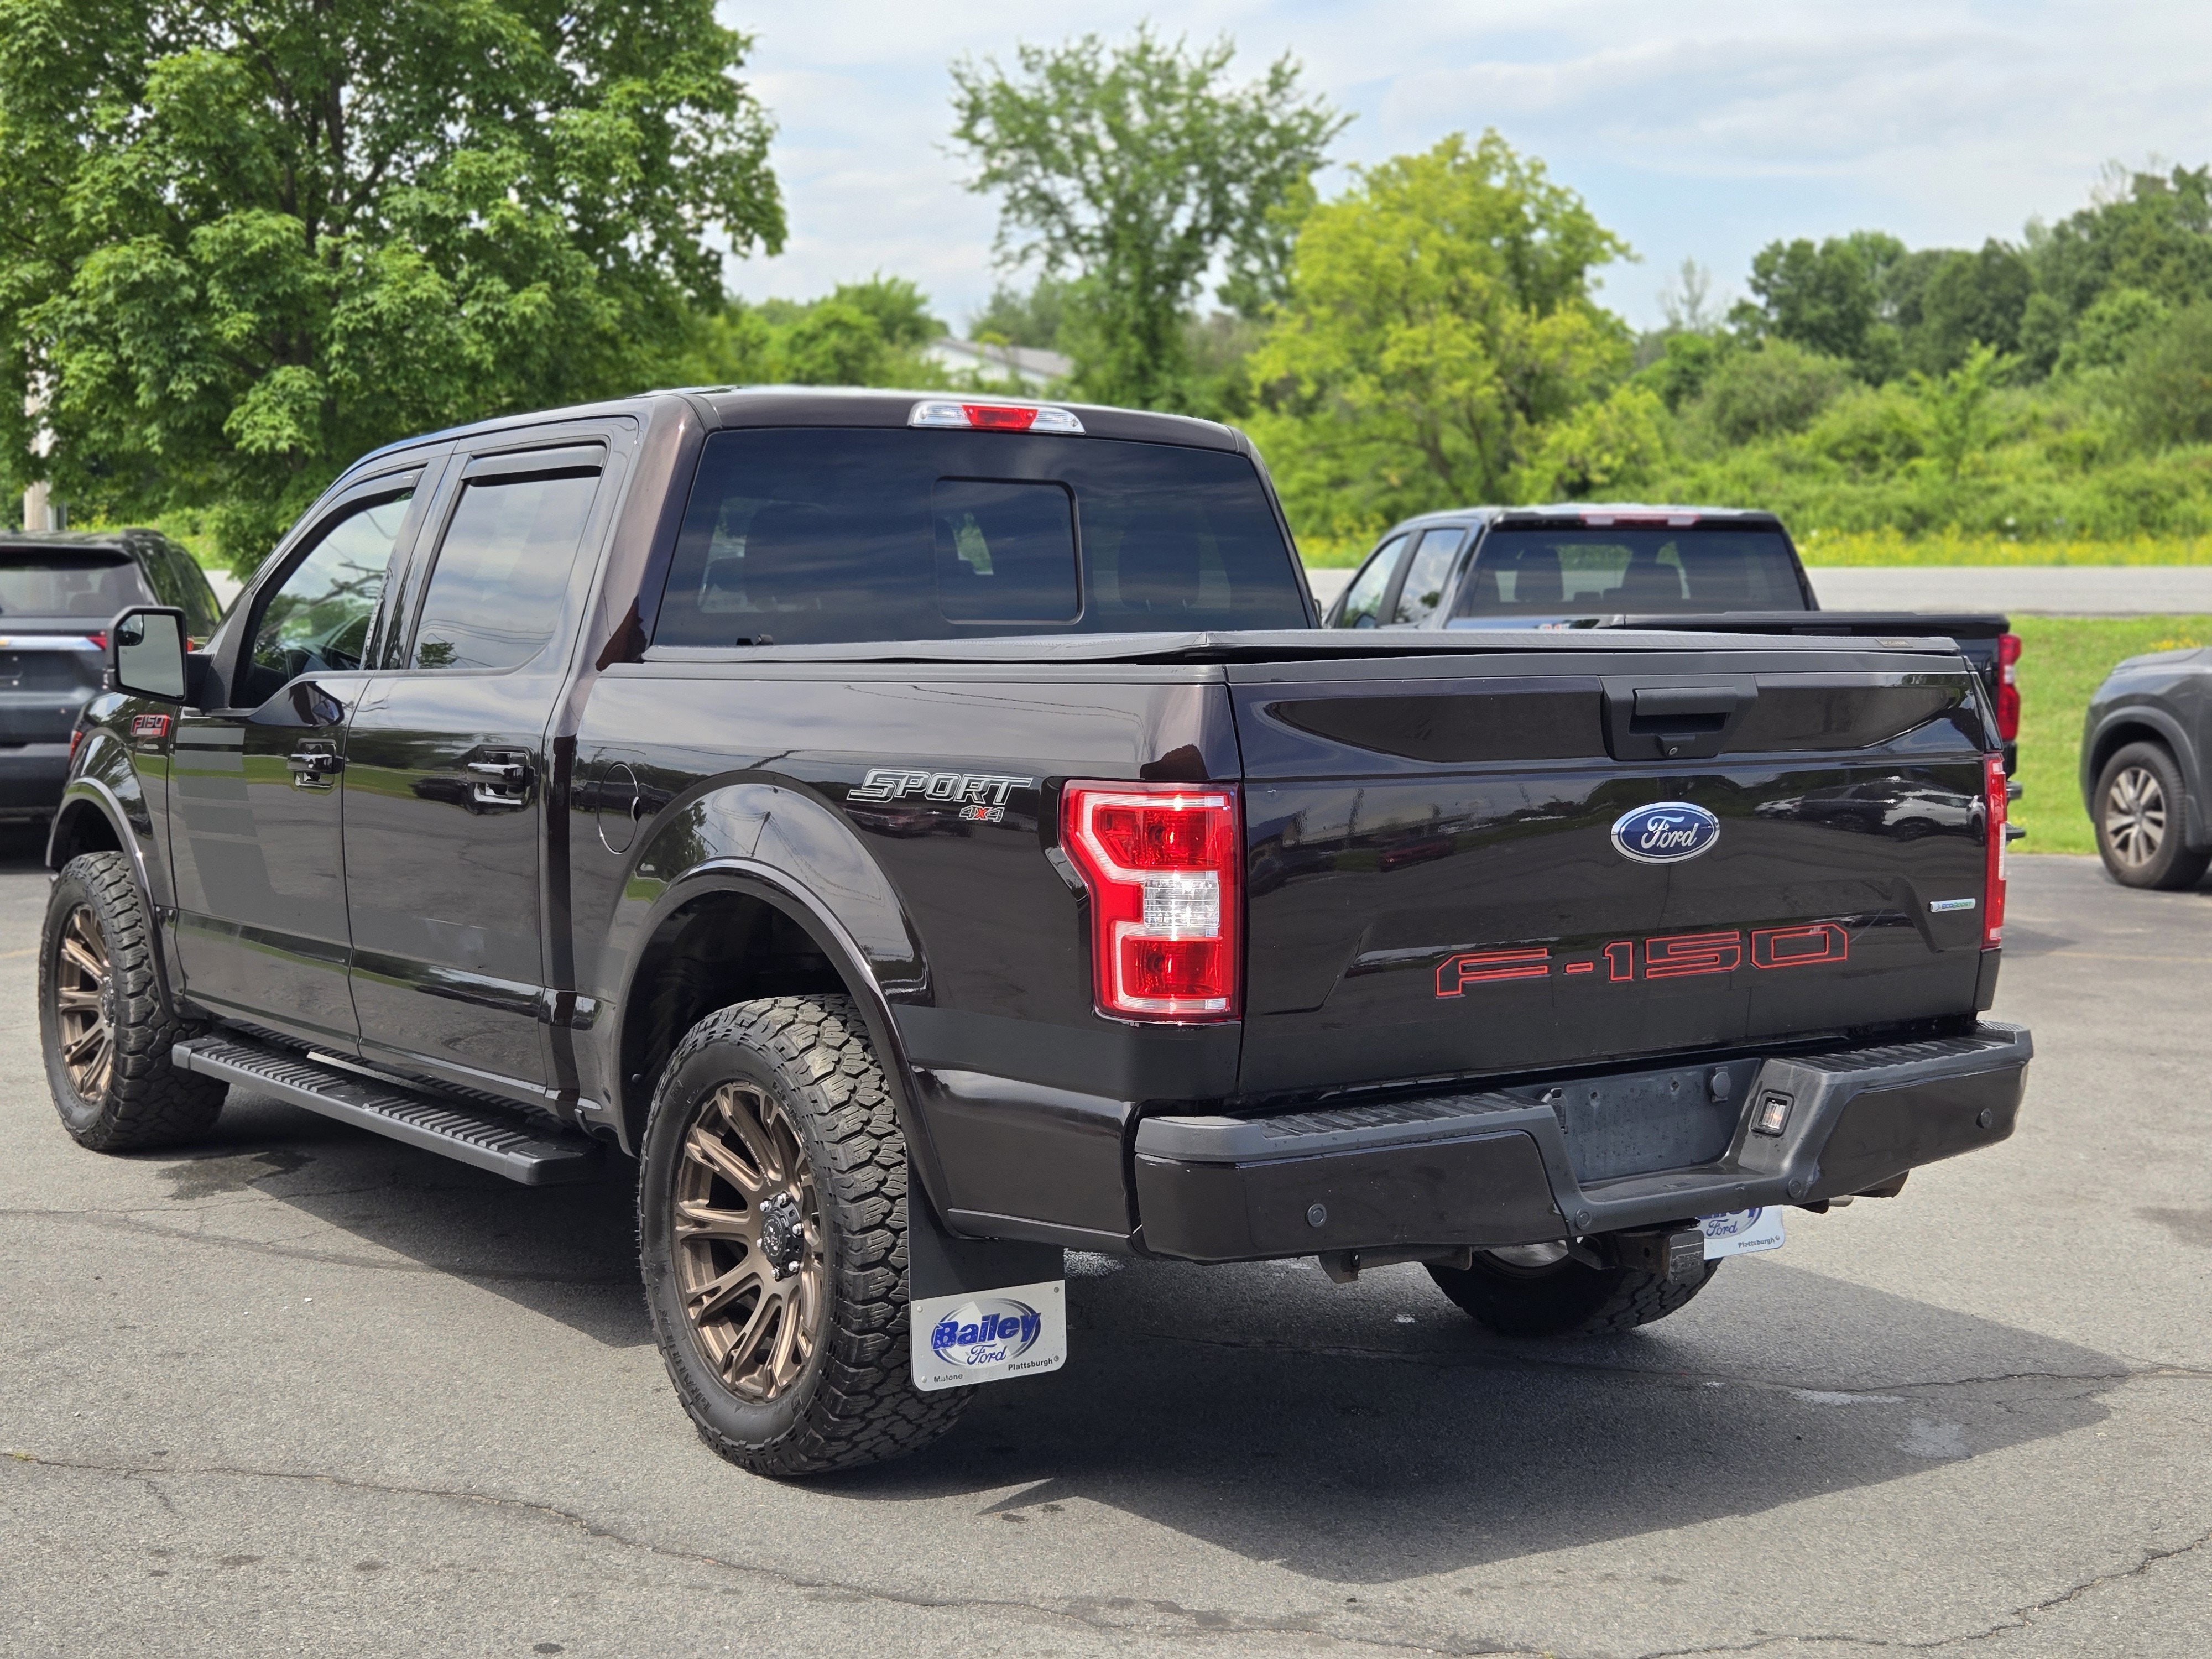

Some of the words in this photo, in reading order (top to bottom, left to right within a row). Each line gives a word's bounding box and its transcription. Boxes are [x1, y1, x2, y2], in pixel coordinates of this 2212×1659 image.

[846, 768, 1034, 805] SPORT
[1641, 816, 1699, 849] Ford
[1436, 924, 1848, 997] F-150
[1706, 1218, 1738, 1237] Ford
[931, 1312, 1041, 1351] Bailey
[967, 1343, 1008, 1365] Ford
[1008, 1358, 1053, 1371] Plattsburgh
